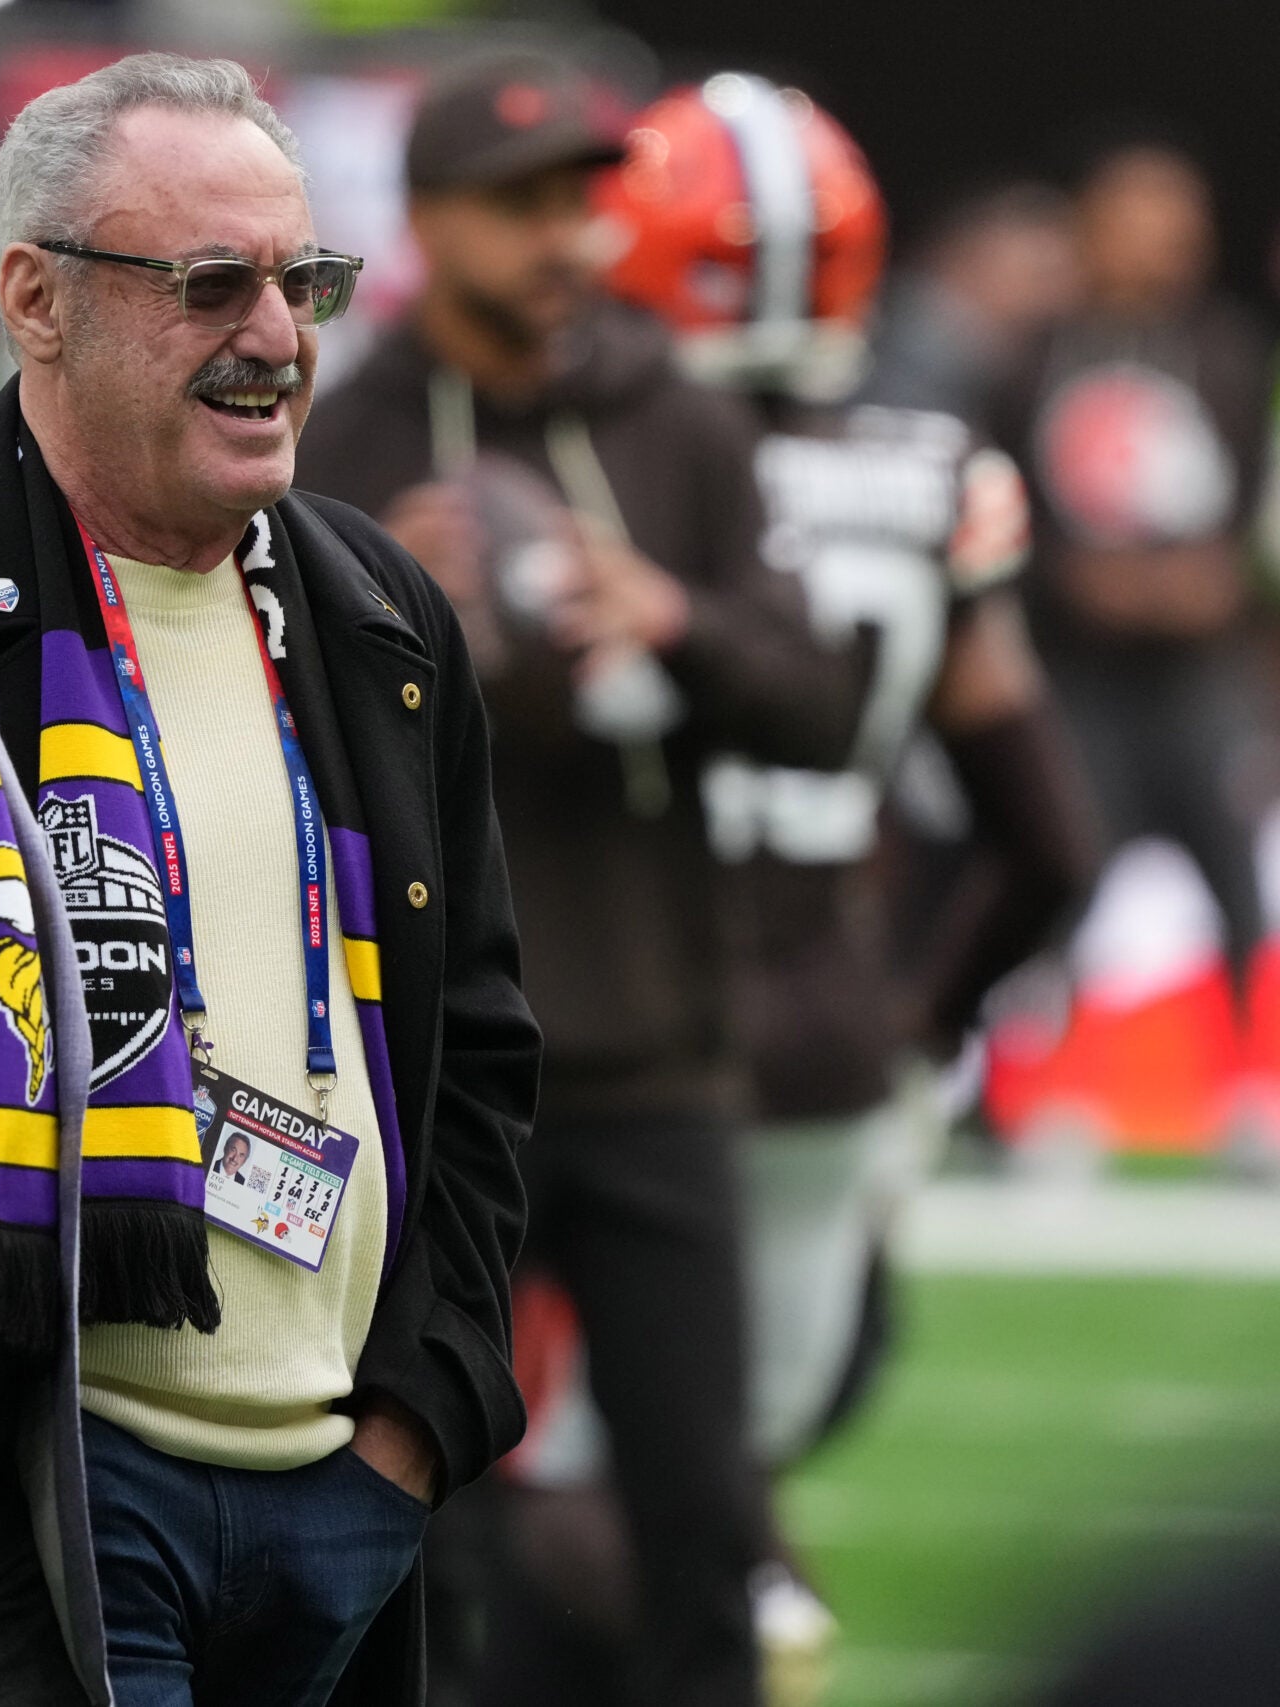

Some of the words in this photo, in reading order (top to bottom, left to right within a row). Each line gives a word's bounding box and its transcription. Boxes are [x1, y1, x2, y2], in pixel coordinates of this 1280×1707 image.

[103, 577, 118, 605] 2025
[138, 724, 156, 769] GAMES
[149, 771, 171, 829] LONDON
[297, 775, 313, 819] GAMES
[47, 831, 89, 872] FL
[166, 834, 176, 860] NFL
[304, 822, 317, 881] LONDON
[169, 864, 181, 893] 2025
[310, 887, 319, 912] NFL
[311, 915, 320, 945] 2025
[74, 940, 167, 975] DON
[229, 1111, 259, 1129] TOTTENHAM
[259, 1126, 282, 1141] HOTSPUR
[281, 1137, 303, 1152] STADIUM
[302, 1147, 321, 1160] ACCESS
[231, 1089, 330, 1150] GAMEDAY
[281, 1167, 289, 1177] 1
[295, 1174, 304, 1185] 2
[310, 1181, 320, 1192] 3
[325, 1189, 333, 1200] 4
[305, 1165, 321, 1178] FIELD
[321, 1172, 341, 1187] ACCESS
[273, 1191, 282, 1201] 9
[304, 1207, 322, 1222] ESC
[277, 1180, 286, 1190] 5
[288, 1186, 303, 1199] 6A
[306, 1194, 315, 1203] 7
[320, 1201, 329, 1212] 8
